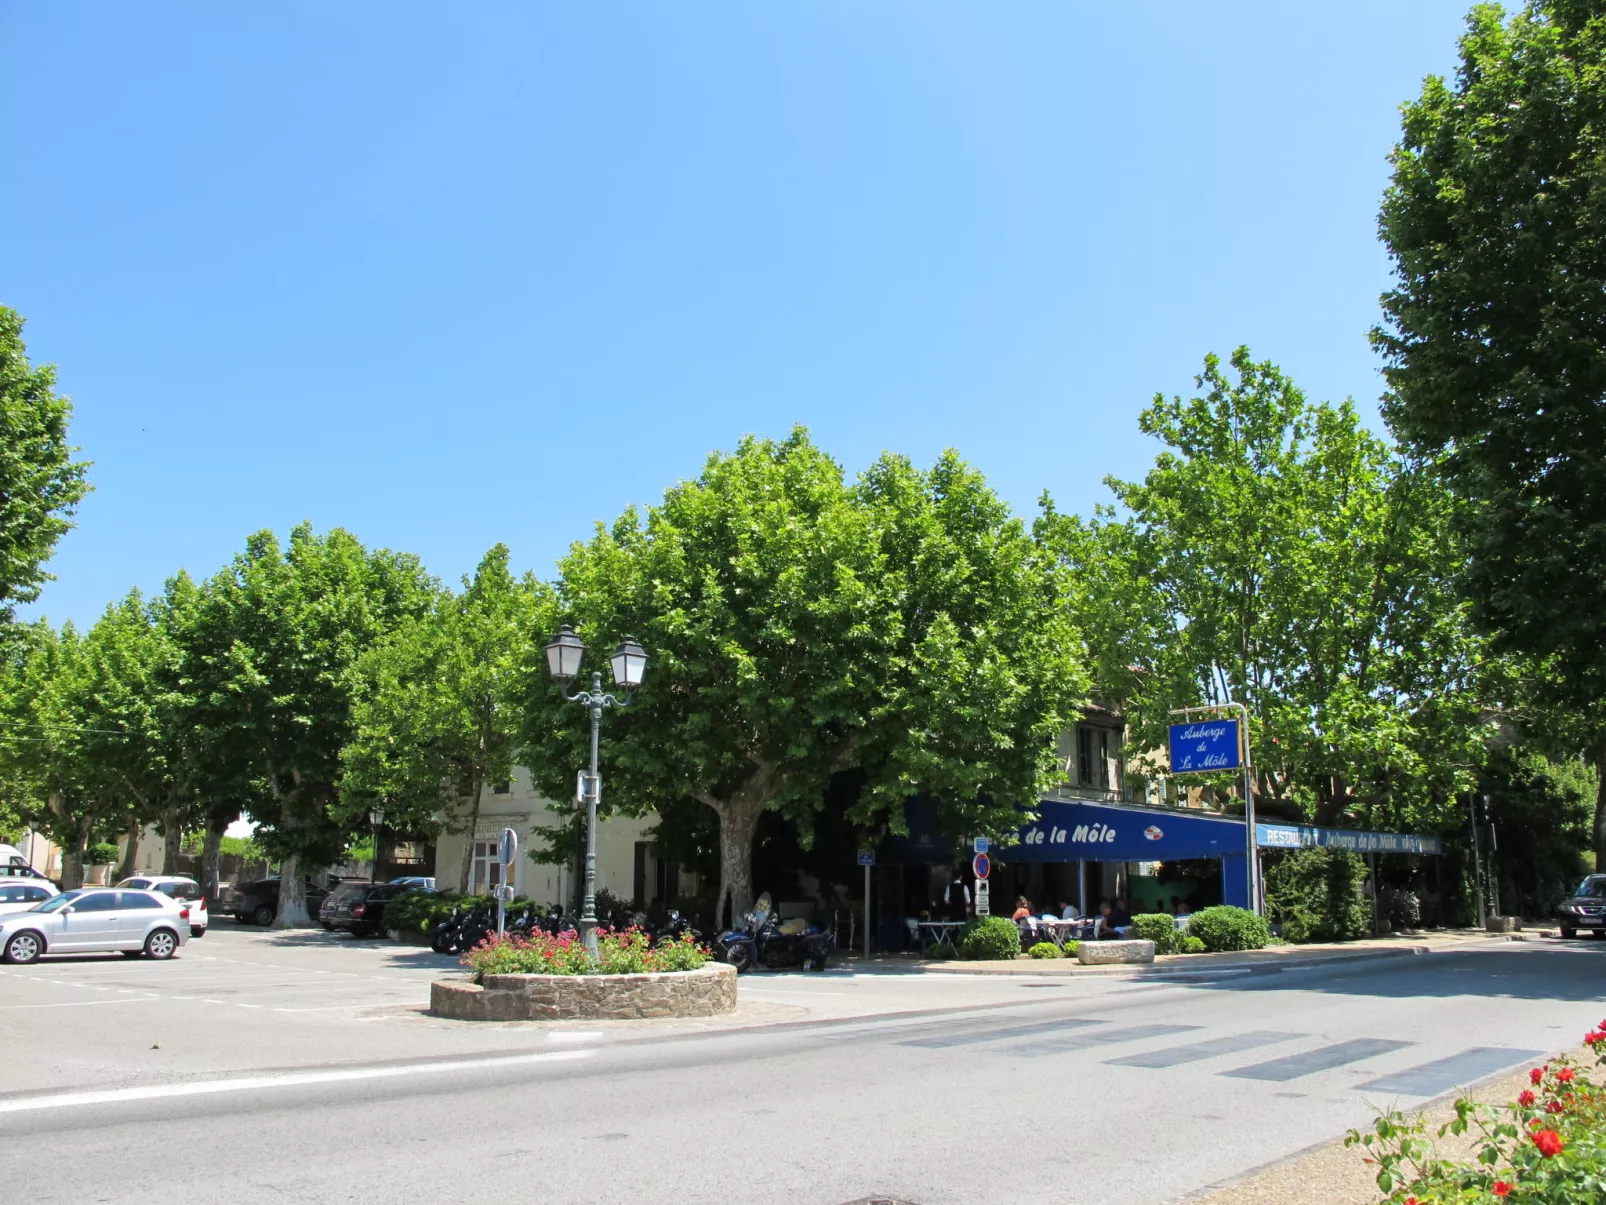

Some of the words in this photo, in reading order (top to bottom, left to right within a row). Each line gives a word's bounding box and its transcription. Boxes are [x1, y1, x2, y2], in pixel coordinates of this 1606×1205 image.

[1180, 724, 1226, 742] Auberge
[1196, 741, 1208, 752] de
[1178, 755, 1193, 770] La
[1197, 752, 1228, 768] Môle
[1025, 827, 1045, 845] de
[1050, 825, 1068, 844] la
[1072, 822, 1116, 843] Môle
